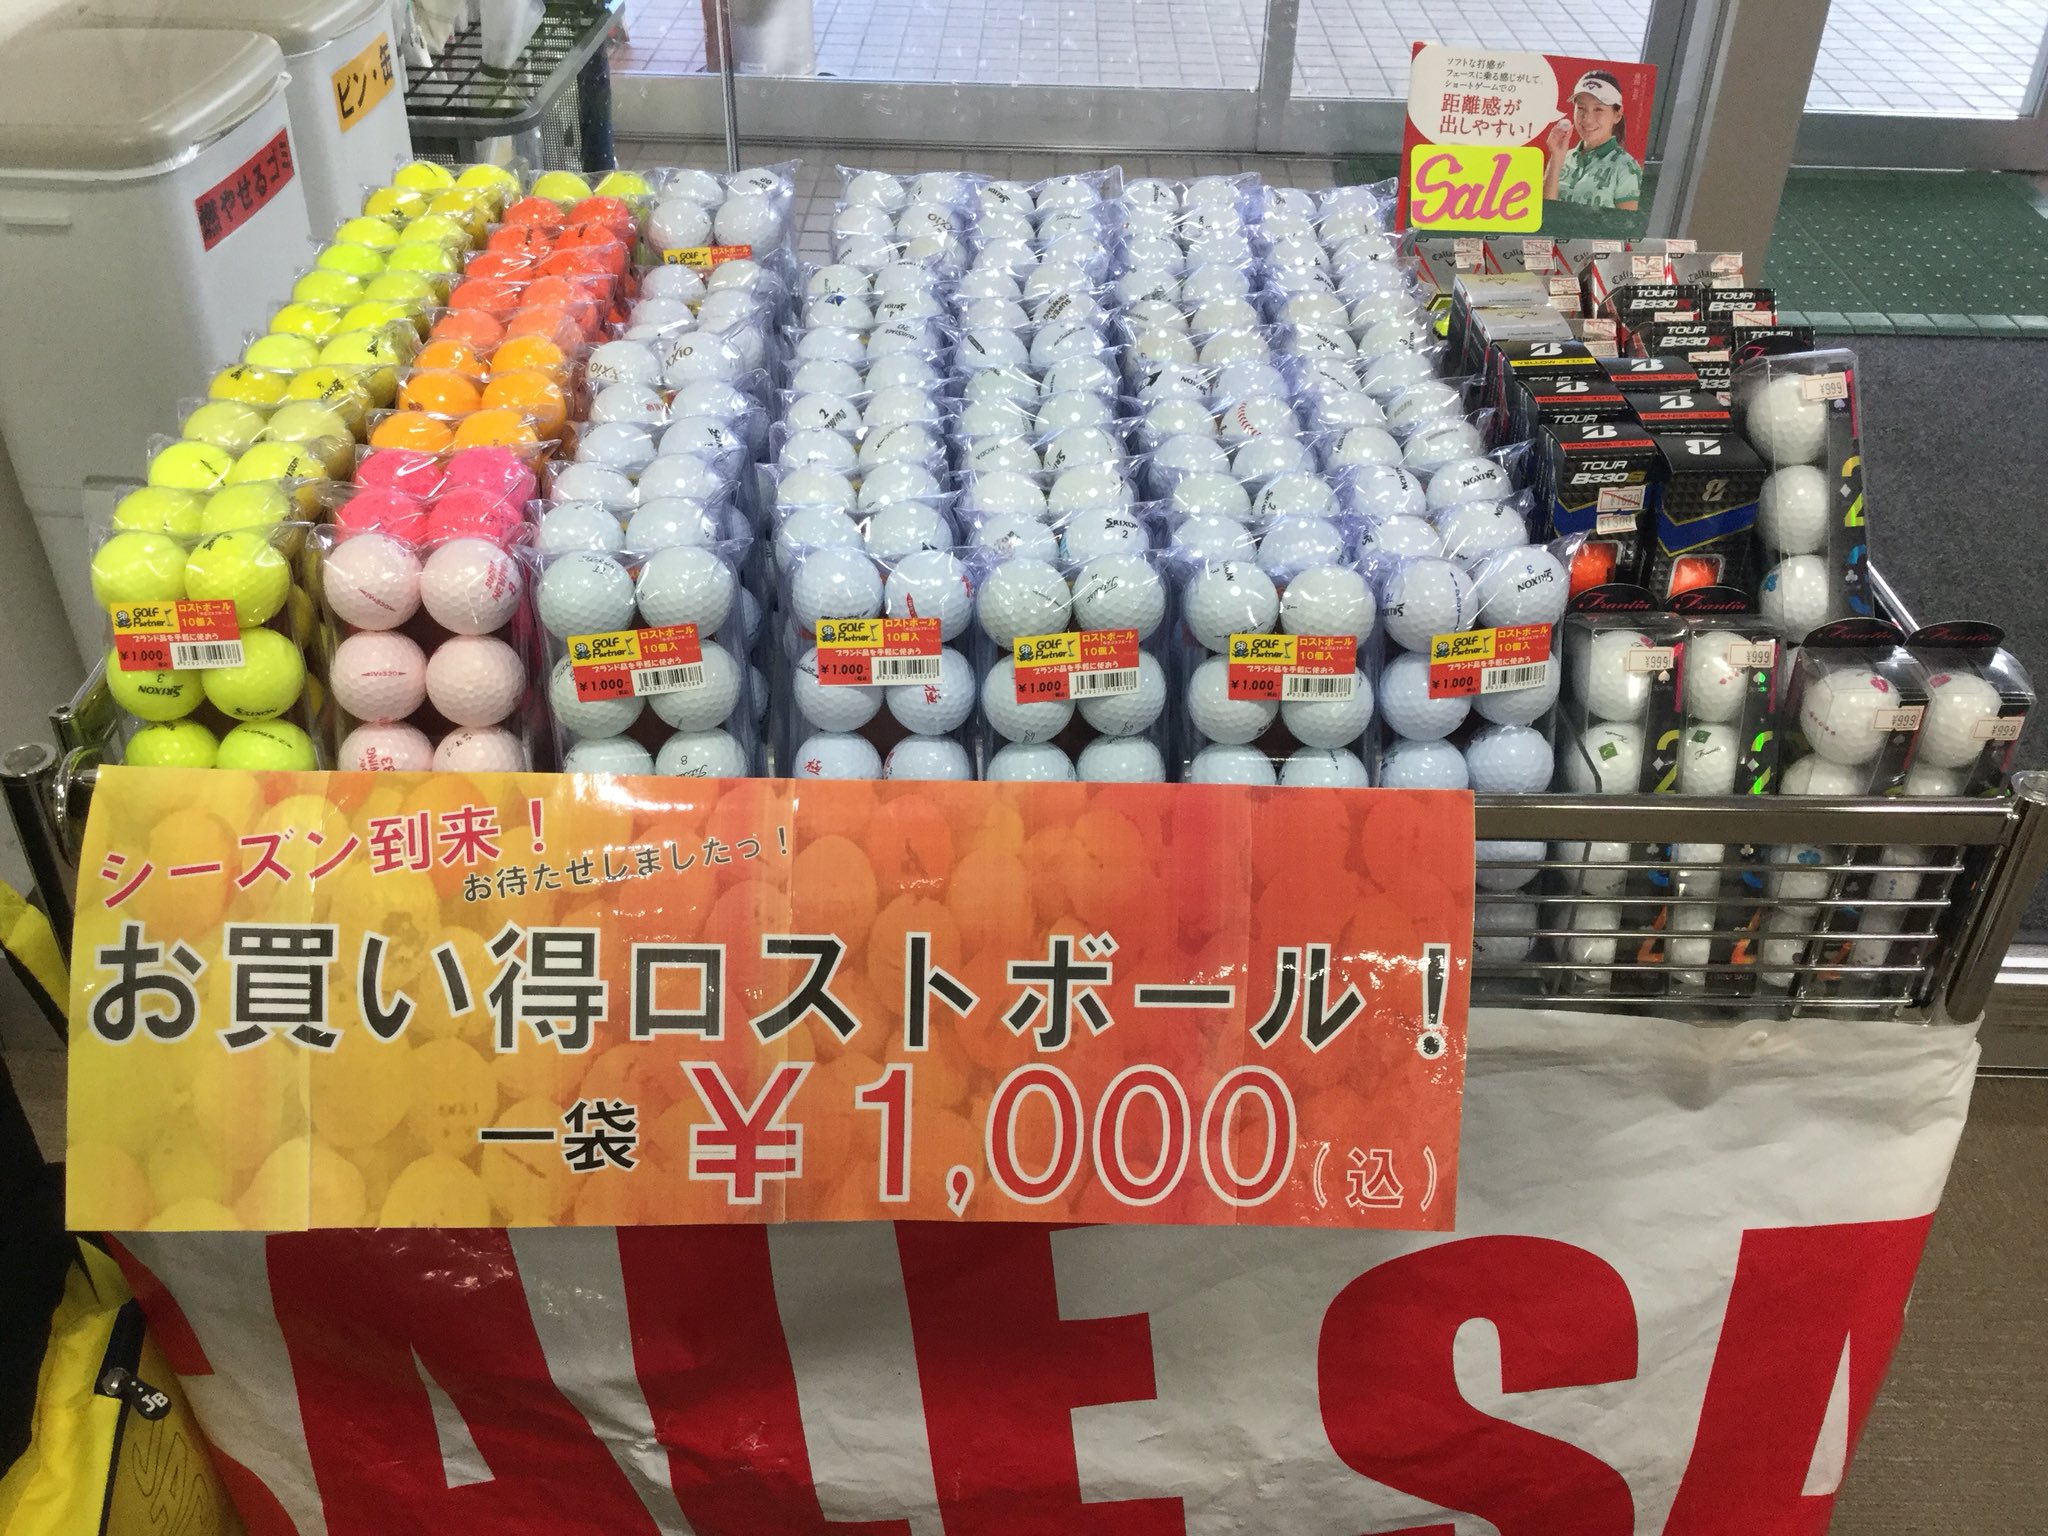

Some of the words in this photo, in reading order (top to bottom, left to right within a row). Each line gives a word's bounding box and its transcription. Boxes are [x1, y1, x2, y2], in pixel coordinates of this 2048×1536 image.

[1446, 57, 1506, 70] ソフトな打感が
[1444, 80, 1517, 93] ショートゲームでの
[1440, 93, 1522, 116] 距離感が
[198, 140, 291, 241] 燃やせるゴミ
[1410, 152, 1532, 225] Sale
[1637, 289, 1676, 298] TOUR
[1715, 292, 1754, 300] TOUR
[1630, 299, 1692, 310] B330X
[1708, 301, 1770, 312] B330X
[1667, 326, 1707, 335] TOUR
[1659, 336, 1726, 347] B330X
[664, 346, 693, 371] XXIO
[589, 362, 621, 381] XXIO
[1699, 367, 1731, 377] TOU
[1819, 381, 1843, 395] ¥999
[819, 408, 830, 420] 2
[1554, 414, 1598, 424] TOUR
[1581, 460, 1628, 471] TOUR
[1462, 467, 1498, 487] SRIXON
[1570, 471, 1648, 485] B330S
[1122, 529, 1129, 539] 2
[1525, 564, 1534, 575] 3
[1517, 567, 1554, 593] SRIXON
[133, 607, 159, 618] GOLF
[178, 602, 231, 613] ロストボール
[132, 617, 166, 629] Partner
[181, 616, 216, 628] 10個入
[838, 622, 865, 633] GOLF
[885, 617, 938, 629] ロストボール
[640, 627, 695, 641] ロストボール
[837, 631, 871, 642] Partner
[886, 631, 920, 642] 10個入
[1082, 631, 1135, 644] ロストボール
[1497, 626, 1550, 640] ロストボール
[592, 637, 620, 649] GOLF
[1036, 639, 1062, 651] GOLF
[1252, 638, 1279, 650] GOLF
[1299, 636, 1353, 647] ロストボール
[1453, 635, 1479, 648] GOLF
[1498, 640, 1531, 653] 10個入
[592, 646, 628, 659] Partner
[643, 641, 679, 655] 10個入
[1084, 646, 1117, 658] 10個入
[1250, 647, 1285, 659] Partner
[1451, 645, 1482, 658] Partner
[1035, 648, 1068, 662] Partner
[1300, 650, 1335, 661] 10個入
[1746, 650, 1770, 663] ¥999
[1645, 655, 1670, 668] ¥999
[157, 673, 165, 684] 3
[138, 683, 184, 698] SRIXON
[232, 707, 278, 717] SRIXON
[1892, 714, 1917, 727] ¥999
[1991, 725, 2017, 737] ¥999
[680, 754, 689, 766] 8
[101, 799, 550, 908] シーズン到来！
[462, 825, 791, 903] お待たせしましたっ！
[88, 919, 1450, 1060] お買い得ロストボール！
[478, 1098, 640, 1176] 一袋
[141, 1391, 169, 1413] JB
